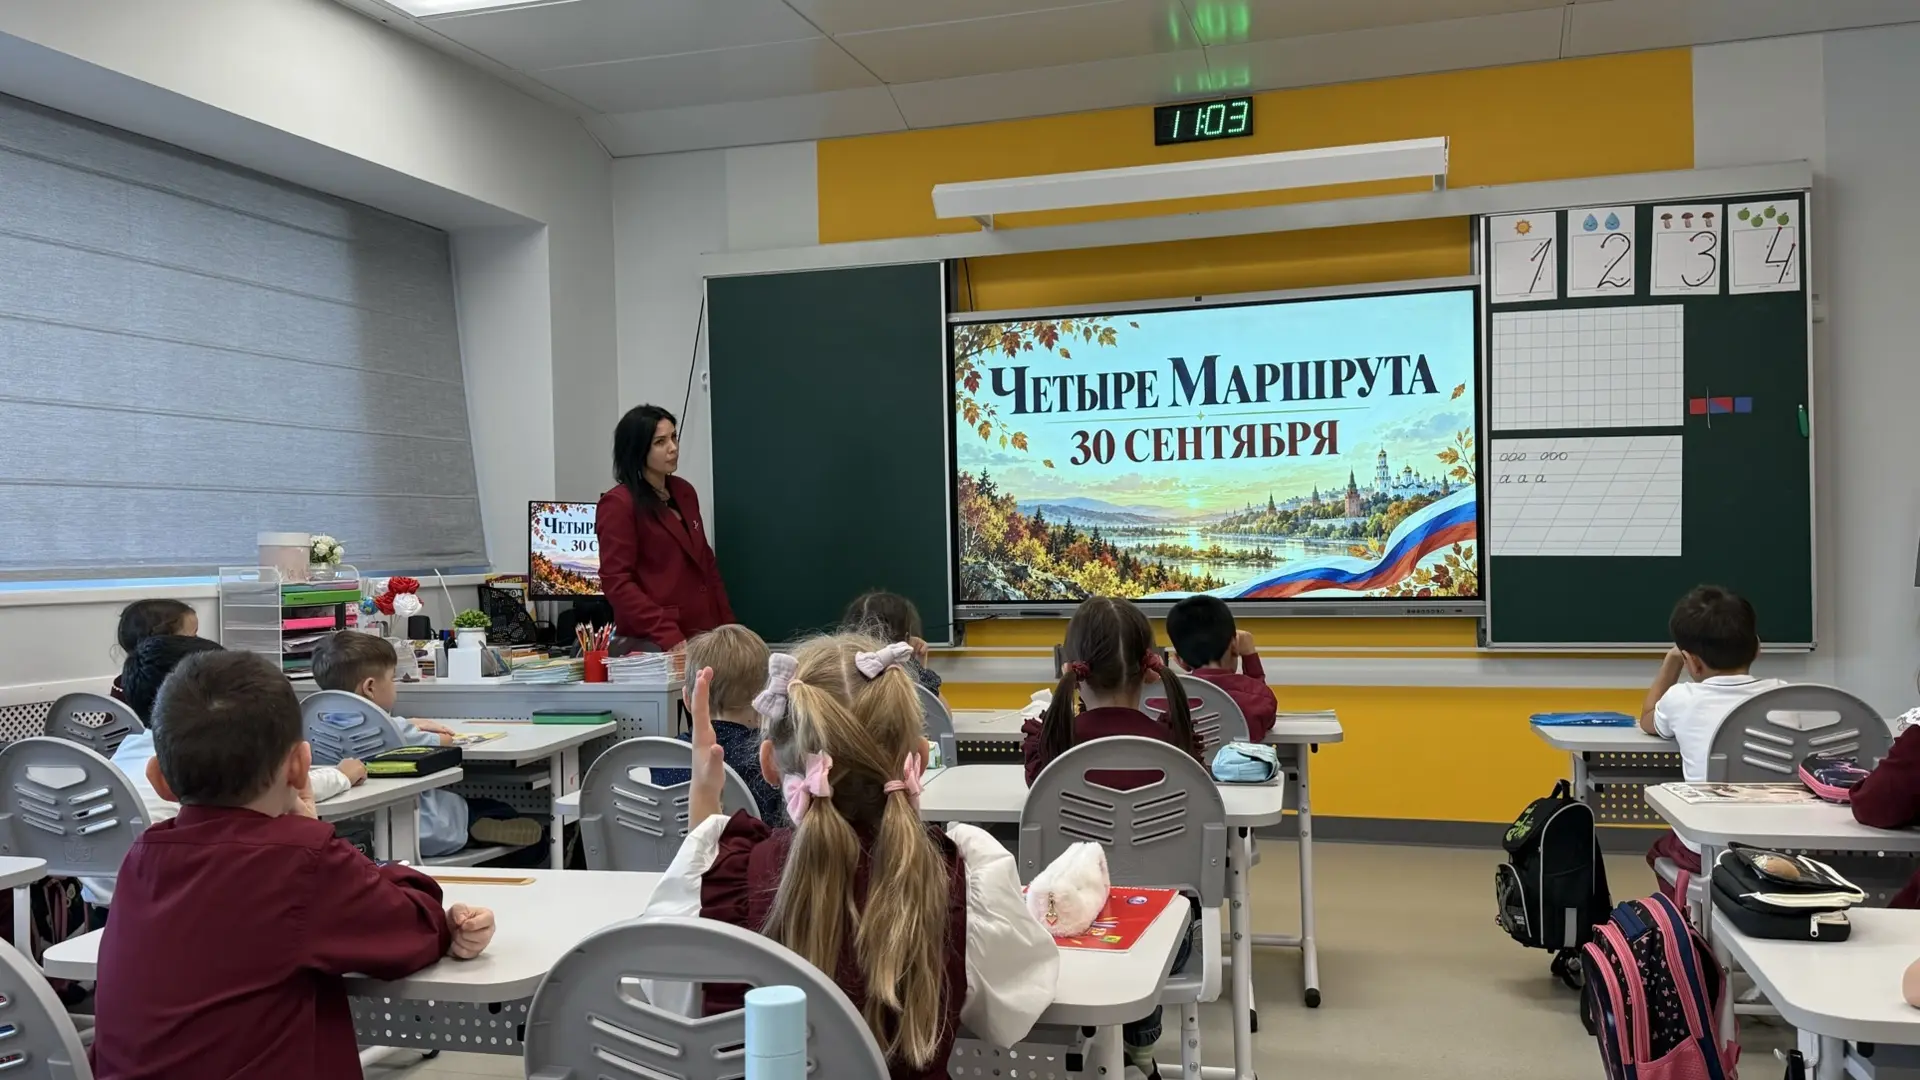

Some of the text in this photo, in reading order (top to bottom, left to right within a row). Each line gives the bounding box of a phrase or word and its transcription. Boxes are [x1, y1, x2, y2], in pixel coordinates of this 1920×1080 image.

[1173, 102, 1248, 138] 11:03
[1530, 238, 1552, 294] 1
[1597, 233, 1631, 288] 2
[1681, 231, 1717, 287] 3
[1765, 226, 1796, 284] 4
[1070, 419, 1340, 466] 30 СЕНТЯБРЯ
[571, 540, 586, 551] 30
